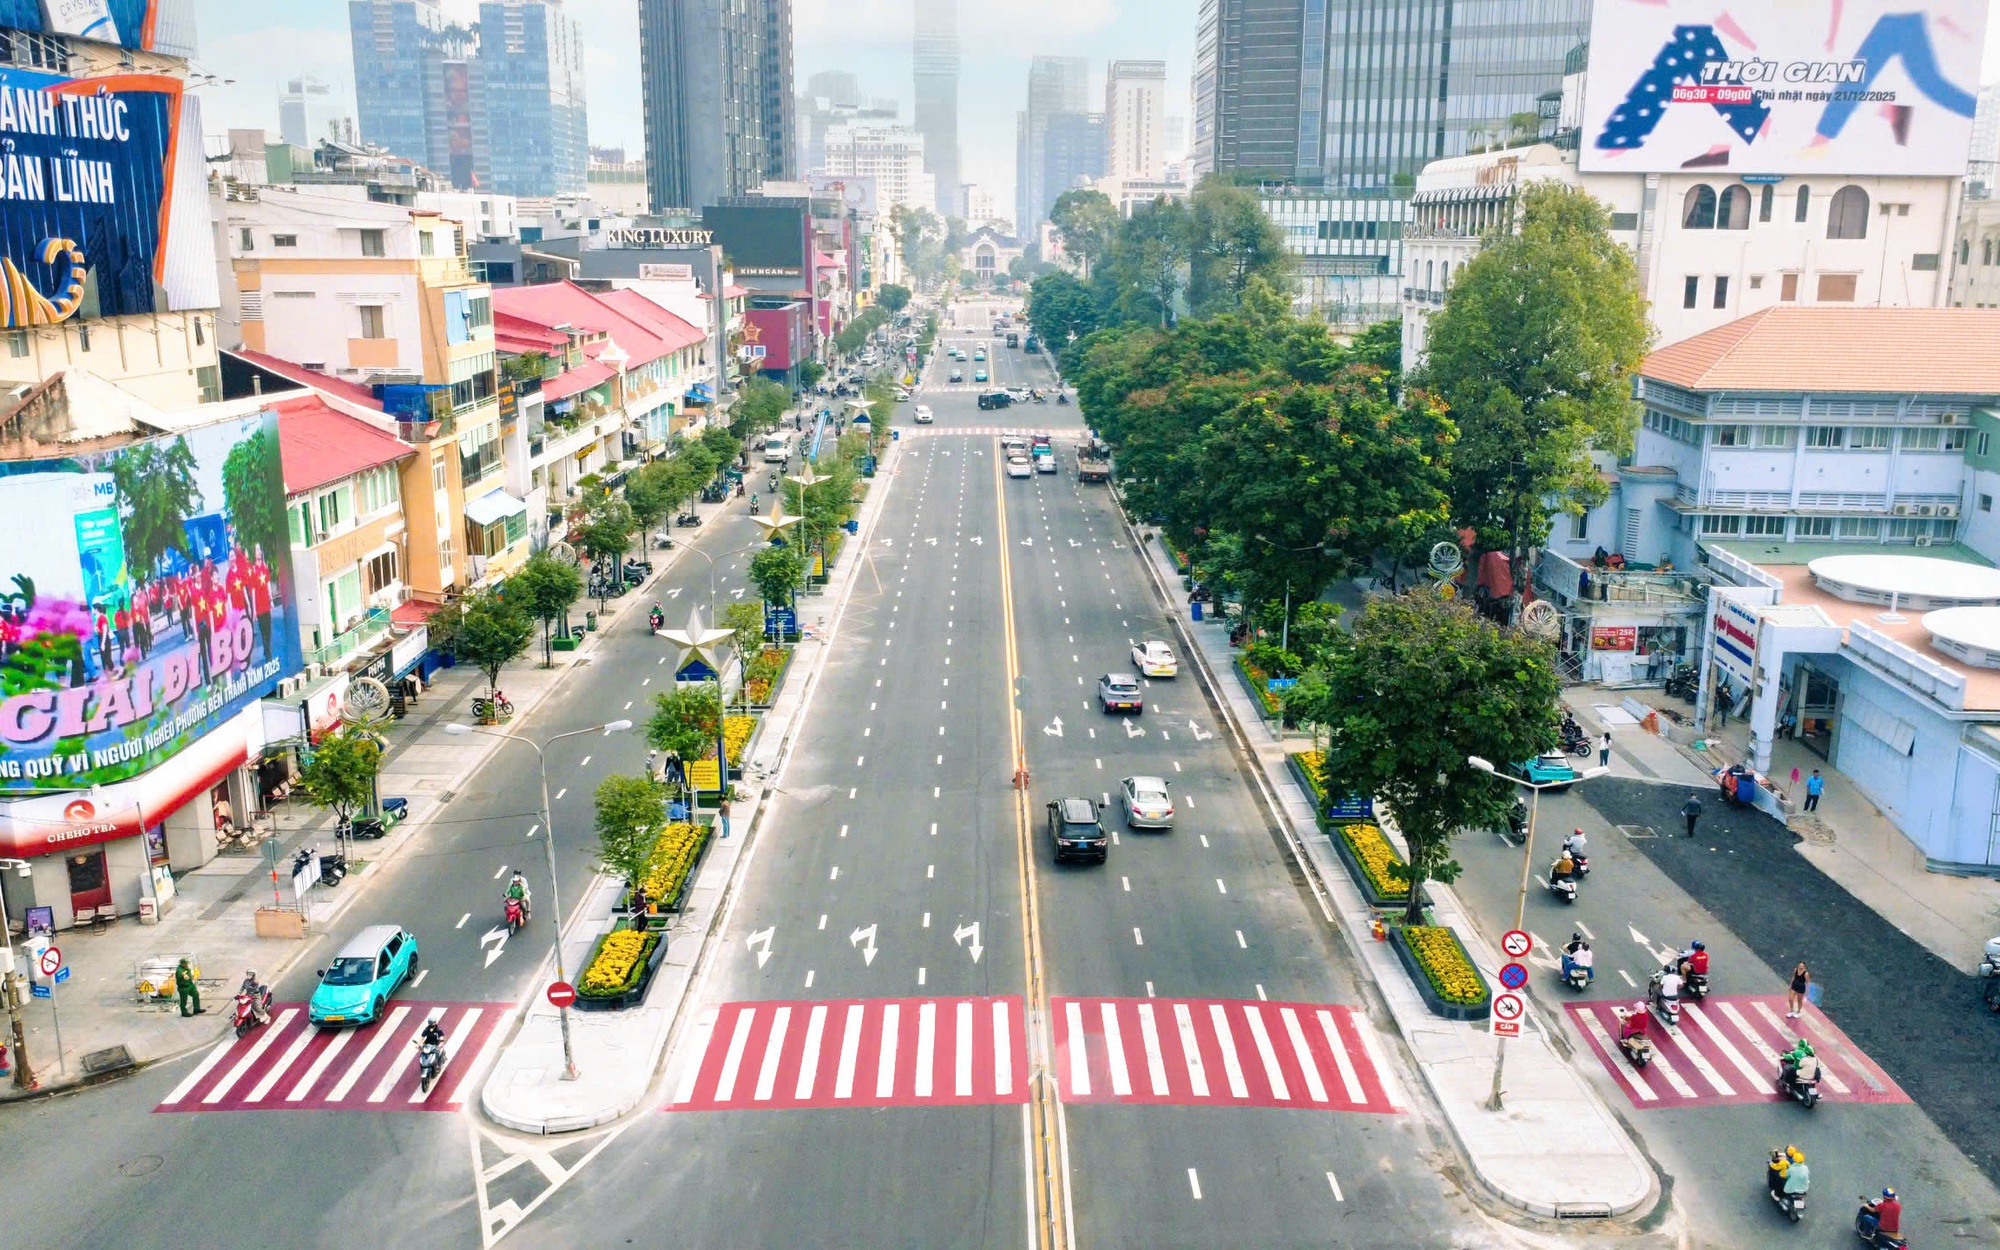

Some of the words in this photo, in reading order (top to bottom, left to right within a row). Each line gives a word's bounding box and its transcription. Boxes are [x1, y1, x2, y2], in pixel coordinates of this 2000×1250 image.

[1673, 88, 1707, 100] 06g30
[1717, 89, 1751, 101] 09g00
[1805, 91, 1832, 102] ngày
[1834, 91, 1896, 102] 21/12/2025
[1702, 57, 1778, 83] THỜI
[1784, 62, 1866, 83] GIAN
[59, 84, 130, 142] THỨC
[51, 148, 115, 204] LĨNH
[606, 229, 646, 243] KING
[650, 229, 714, 244] LUXURY
[210, 615, 254, 676] BỘ
[24, 754, 64, 779] QUỸ
[94, 736, 143, 768] NGƯỜI
[264, 657, 280, 680] 2025
